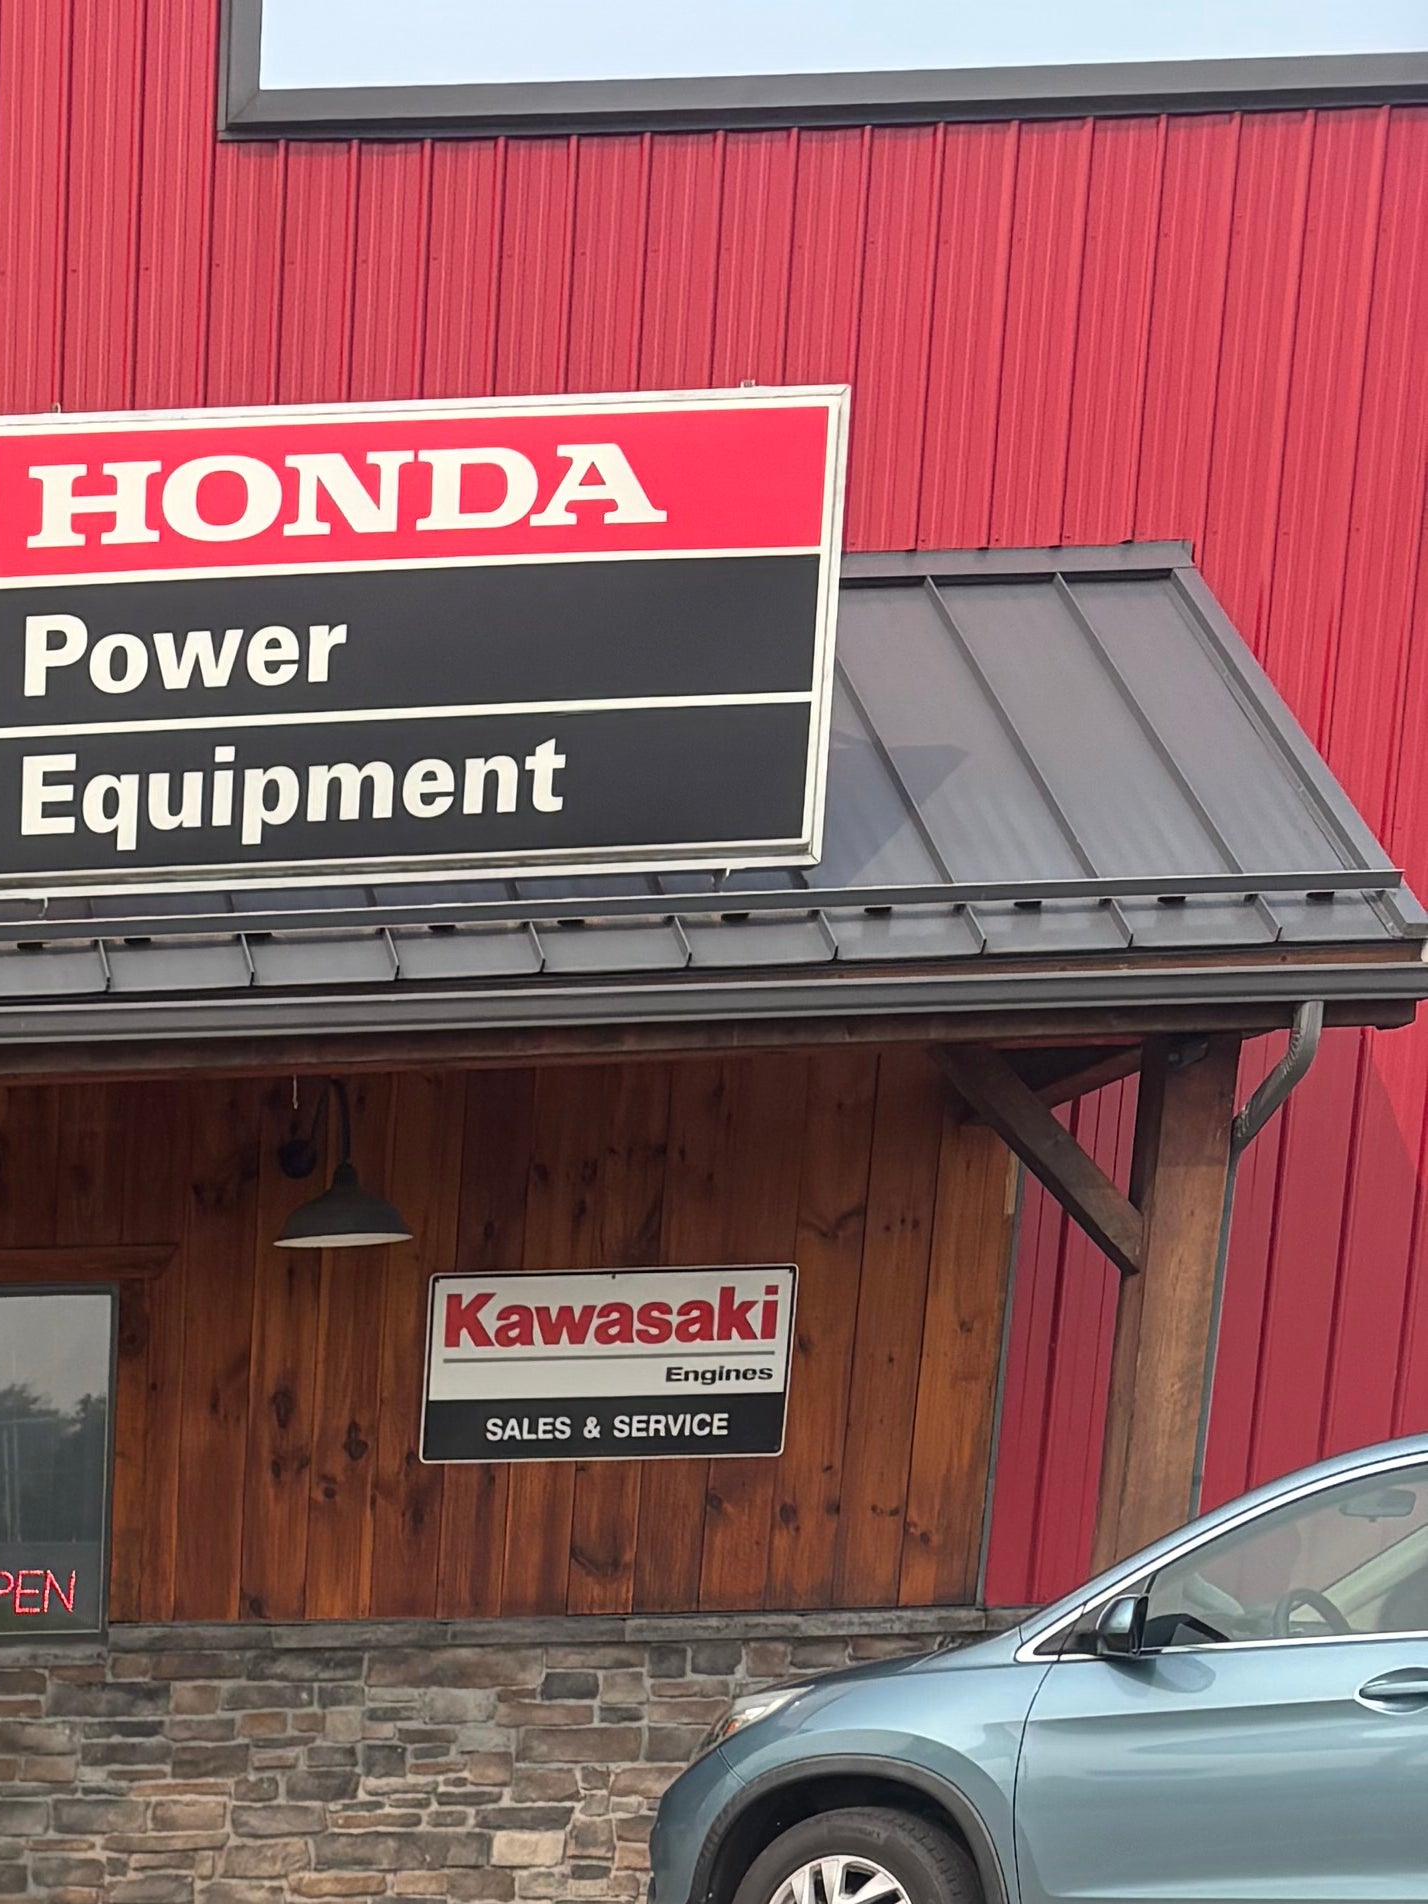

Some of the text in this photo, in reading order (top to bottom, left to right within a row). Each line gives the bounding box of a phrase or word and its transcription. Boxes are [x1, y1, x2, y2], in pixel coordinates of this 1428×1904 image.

[26, 442, 668, 549] HONDA
[22, 613, 348, 698] Power
[19, 737, 567, 852] Equipment
[443, 1284, 780, 1349] Kawasaki
[665, 1365, 774, 1386] Engines
[485, 1412, 730, 1441] SALES & SERVICE
